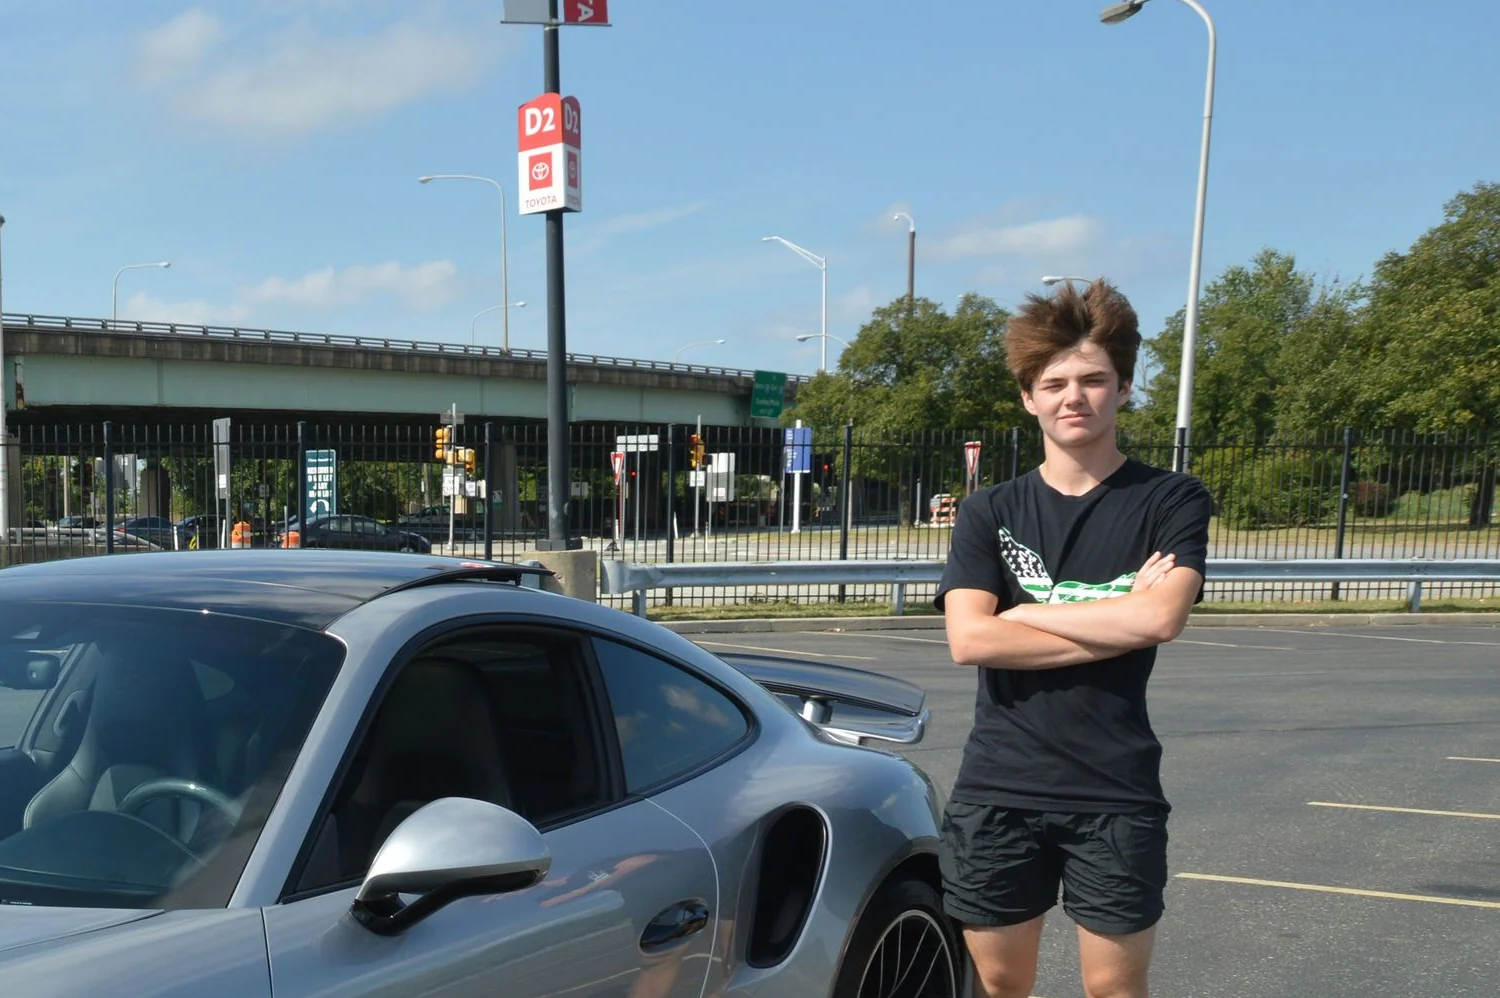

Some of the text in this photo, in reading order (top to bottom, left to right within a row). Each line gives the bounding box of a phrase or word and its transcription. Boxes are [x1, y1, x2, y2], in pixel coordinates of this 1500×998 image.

[578, 0, 594, 22] A
[525, 107, 556, 136] D2
[564, 103, 579, 135] D2
[525, 195, 558, 208] TOYOTA
